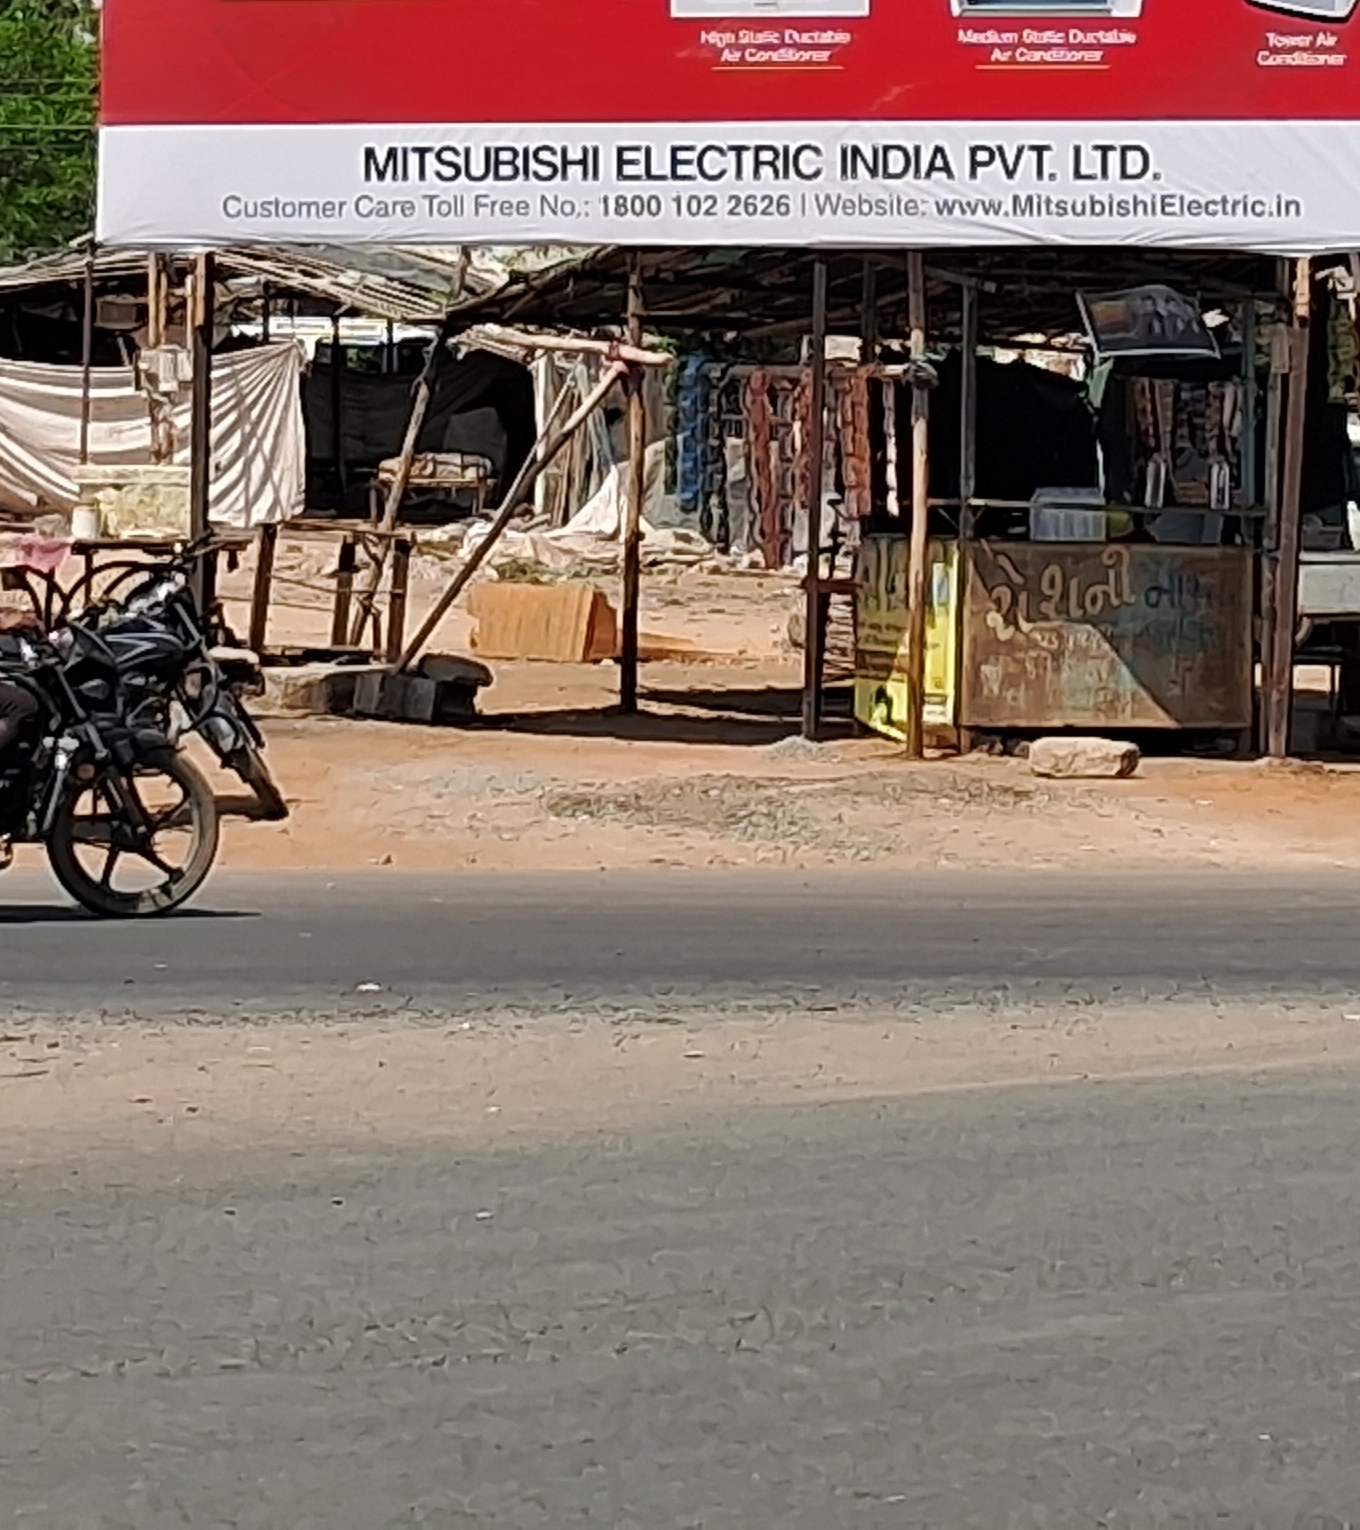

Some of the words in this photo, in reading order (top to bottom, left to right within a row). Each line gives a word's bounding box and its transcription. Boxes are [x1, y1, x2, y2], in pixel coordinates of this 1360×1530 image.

[700, 30, 736, 47] High
[738, 30, 782, 45] Static
[784, 29, 851, 45] Ductable
[957, 28, 1019, 44] Medium
[1021, 28, 1066, 44] Static
[1068, 28, 1137, 44] Ductable
[1265, 32, 1314, 48] Tower
[1315, 32, 1338, 47] Air
[720, 48, 742, 62] Air
[744, 47, 832, 62] Conditioner
[990, 48, 1013, 62] Air
[1014, 46, 1104, 62] Conditioner
[1257, 50, 1347, 66] Conditioner
[362, 145, 600, 182] MITSUBISHI
[616, 143, 823, 182] ELECTRIC
[840, 144, 955, 181] INDIA
[968, 144, 1057, 182] PVT.
[1072, 144, 1161, 181] LTD.
[222, 194, 347, 219] Customer
[354, 194, 416, 218] Care
[420, 194, 465, 218] Toll
[474, 194, 530, 217] Free
[599, 194, 662, 218] 1800
[671, 194, 718, 218] 102
[726, 194, 791, 218] 2626
[814, 192, 929, 217] Website:
[933, 192, 1301, 218] www.MitsubishiElectric.in
